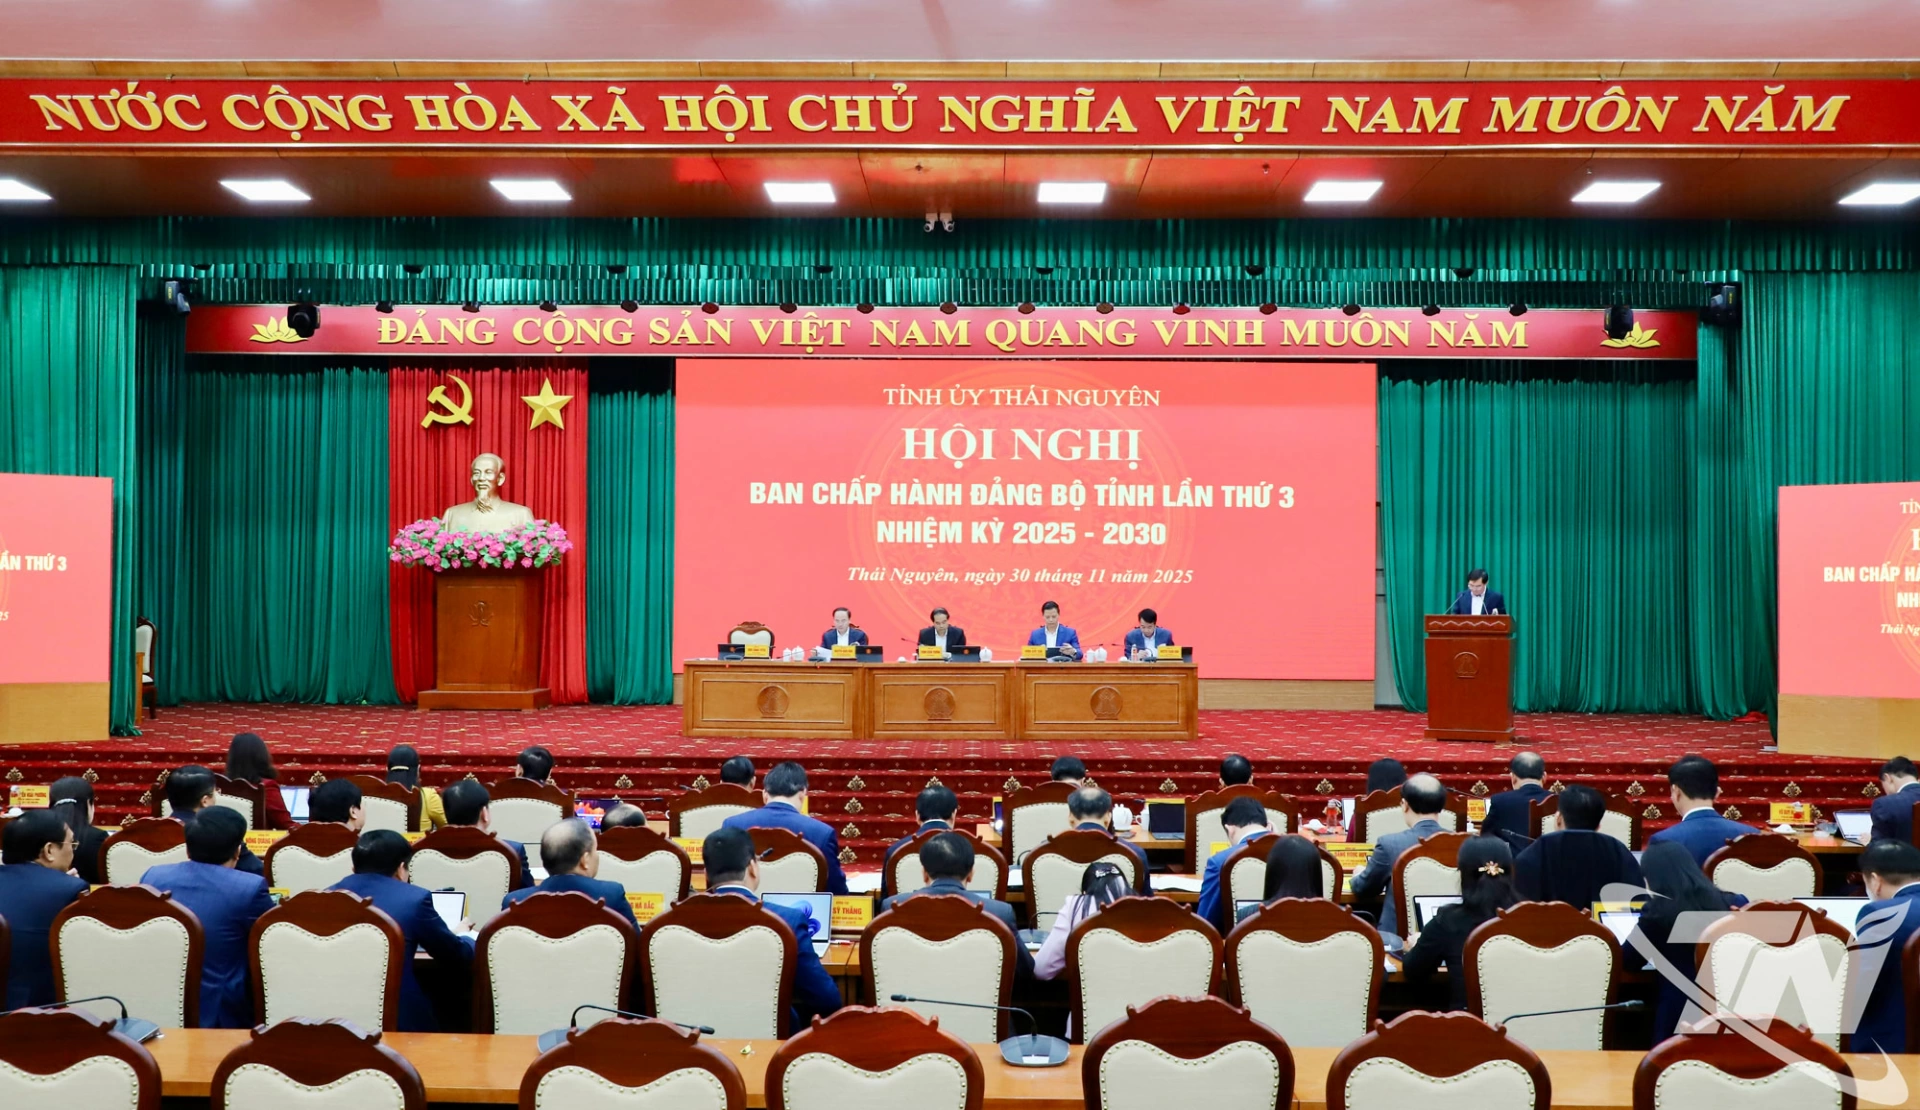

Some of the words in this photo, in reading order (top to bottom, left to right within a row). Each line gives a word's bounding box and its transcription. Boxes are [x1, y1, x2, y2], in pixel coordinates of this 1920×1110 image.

[29, 82, 206, 132] NƯỚC
[223, 84, 393, 141] CỘNG
[413, 82, 541, 132] HÒA
[558, 86, 645, 132] XÃ
[663, 84, 770, 142] HỘI
[789, 83, 917, 133] CHỦ
[939, 87, 1138, 133] NGHĨA
[1156, 86, 1301, 143] VIỆT
[1323, 97, 1463, 133] NAM
[1484, 85, 1672, 133] MUÔN
[1693, 84, 1850, 132] NĂM
[378, 311, 496, 344] ĐẢNG
[512, 312, 633, 352] CỘNG
[650, 310, 733, 344] SẢN
[751, 312, 851, 354] VIỆT
[871, 320, 969, 346] NAM
[986, 320, 1137, 351] QUANG
[1154, 320, 1264, 346] VINH
[1283, 314, 1410, 346] MUÔN
[1429, 315, 1527, 347] NĂM
[883, 384, 942, 405] TỈNH
[949, 383, 985, 405] ỦY
[989, 384, 1048, 406] THÁI
[1055, 385, 1160, 407] NGUYÊN
[901, 422, 996, 468] HỘI
[1010, 428, 1142, 470] NGHỊ
[750, 482, 804, 505] BAN
[812, 475, 882, 505] CHẤP
[890, 478, 963, 506] HÀNH
[970, 476, 1043, 506] ĐẢNG
[1051, 479, 1087, 511] BỘ
[1094, 477, 1155, 507] TỈNH
[1162, 477, 1213, 508] LẦN
[1220, 481, 1274, 508] THỨ
[1279, 486, 1295, 509] 3
[1899, 499, 1920, 514] TỈN
[876, 517, 963, 548] NHIỆM
[971, 517, 1005, 545] KỲ
[1012, 521, 1076, 545] 2025
[1102, 522, 1167, 546] 2030
[0, 550, 21, 571] ẦN
[25, 553, 56, 571] THỨ
[57, 556, 67, 571] 3
[1823, 566, 1855, 582] BAN
[1859, 561, 1900, 582] CHẤP
[847, 566, 886, 582] Thái
[890, 567, 959, 586] Nguyên,
[964, 568, 1006, 586] ngày
[1009, 568, 1031, 582] 30
[1034, 568, 1083, 586] tháng
[1088, 568, 1106, 583] 11
[1111, 569, 1149, 583] năm
[1152, 569, 1194, 584] 2025
[1880, 623, 1903, 635] Thái
[842, 905, 862, 915] THẮNG
